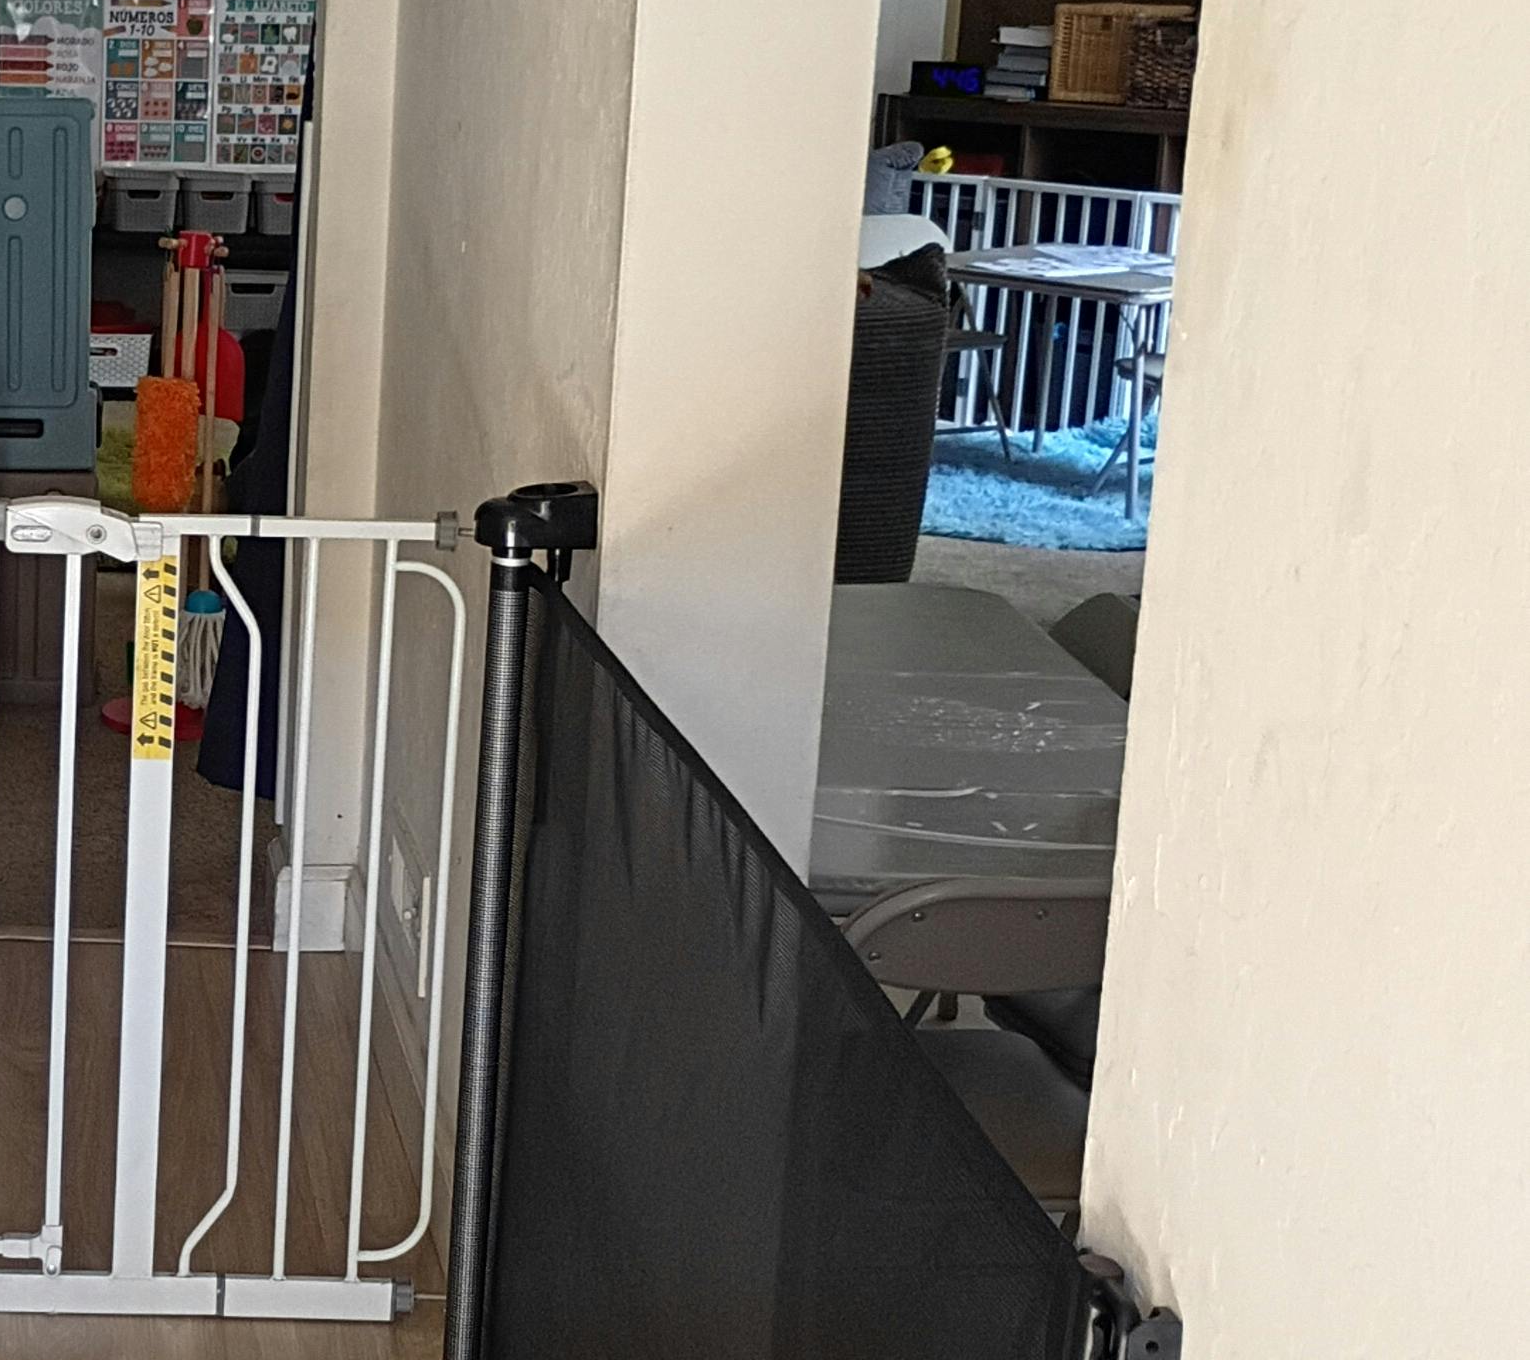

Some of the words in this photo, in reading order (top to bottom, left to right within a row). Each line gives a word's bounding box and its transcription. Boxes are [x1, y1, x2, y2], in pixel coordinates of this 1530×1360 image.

[13, 0, 84, 15] COLORES
[109, 9, 174, 23] NÚMEROS
[129, 24, 155, 36] 1-10
